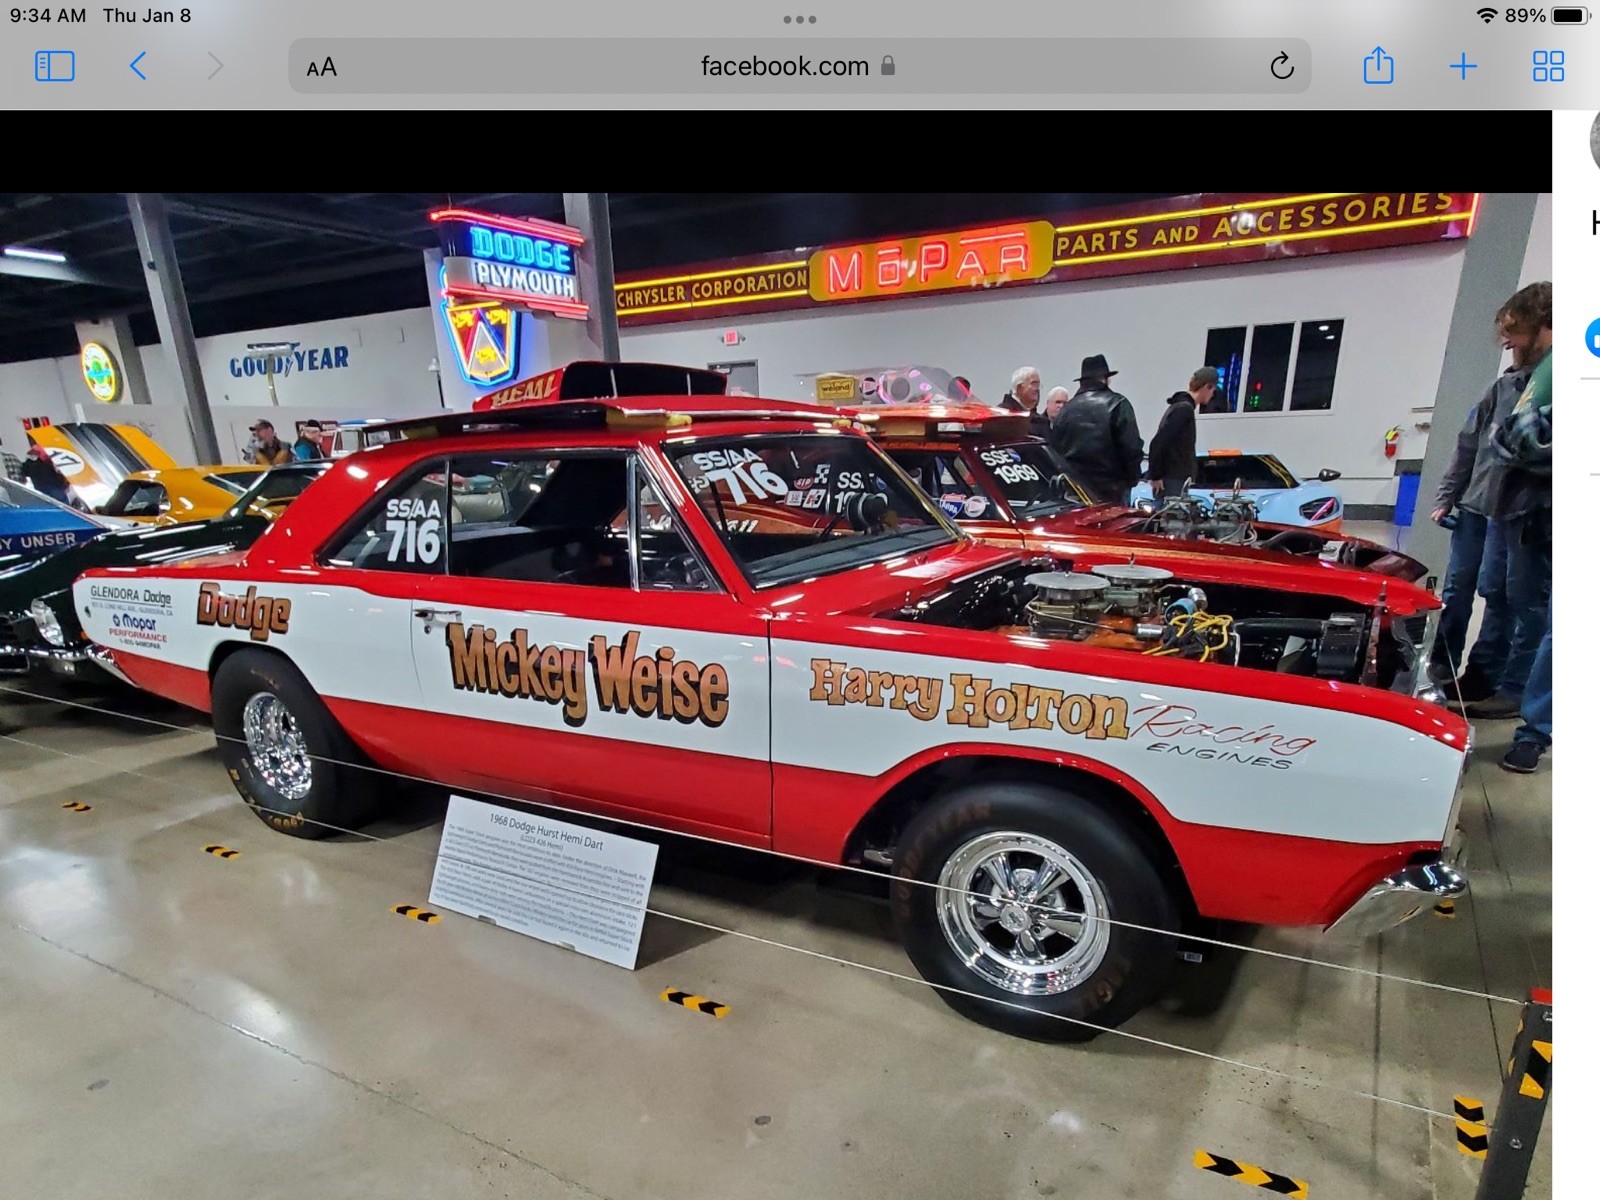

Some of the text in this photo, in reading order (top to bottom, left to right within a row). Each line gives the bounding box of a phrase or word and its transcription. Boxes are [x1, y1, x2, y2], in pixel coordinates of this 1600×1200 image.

[1056, 193, 1453, 256] PARTS AND ACCESSORIES
[470, 226, 571, 272] DODGE
[475, 262, 574, 297] PLYMOUTH
[617, 270, 807, 307] CHRYSLER CORPORATION
[230, 345, 349, 378] GOODYEAR
[492, 374, 555, 406] HEMI
[692, 447, 763, 471] SS/AA
[993, 464, 1040, 484] 1969
[705, 462, 789, 506] 716
[386, 498, 441, 520] SS/AA
[20, 532, 76, 549] UNSER
[385, 519, 441, 564] 716
[91, 585, 171, 607] GLENDORA Dodge
[197, 581, 292, 642] Dodge
[109, 628, 167, 642] PERFORMANCE
[122, 613, 156, 631] Mopar
[445, 622, 730, 728] Mickey Weise
[809, 658, 943, 721] Harry
[1130, 705, 1317, 756] Racing
[1146, 742, 1293, 770] ENGINES
[490, 813, 508, 826] 1968
[509, 818, 536, 834] Dodge
[536, 825, 560, 840] Hurst
[560, 831, 584, 845] Hemi
[584, 836, 604, 851] Dart
